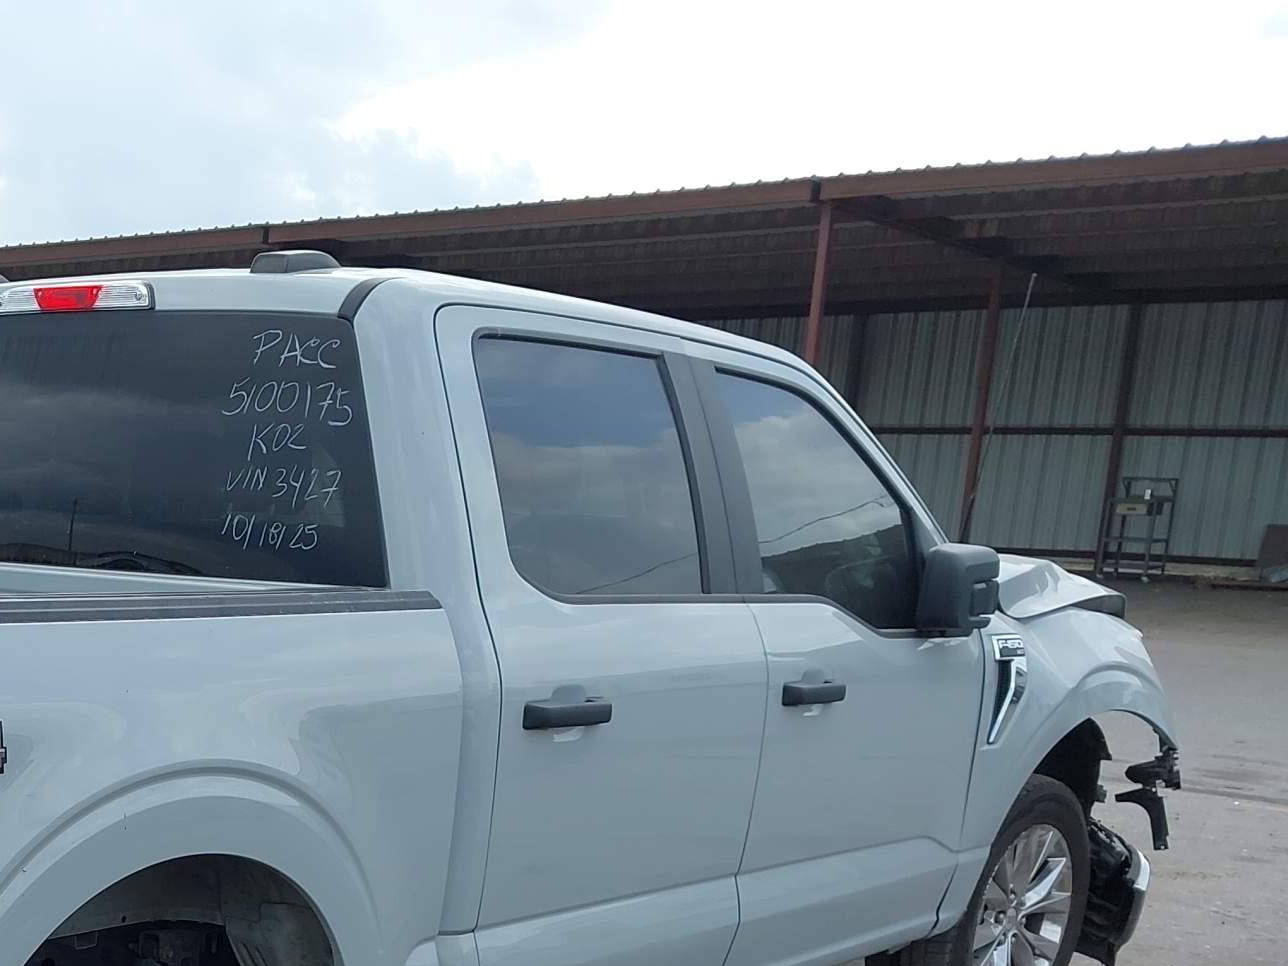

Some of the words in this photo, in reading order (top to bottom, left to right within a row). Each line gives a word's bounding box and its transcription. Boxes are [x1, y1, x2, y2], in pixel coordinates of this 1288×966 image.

[252, 329, 341, 369] PACC
[222, 377, 353, 426] 5100175
[225, 466, 268, 491] VIN
[271, 464, 343, 508] 3427
[221, 513, 319, 550] 10/18/25
